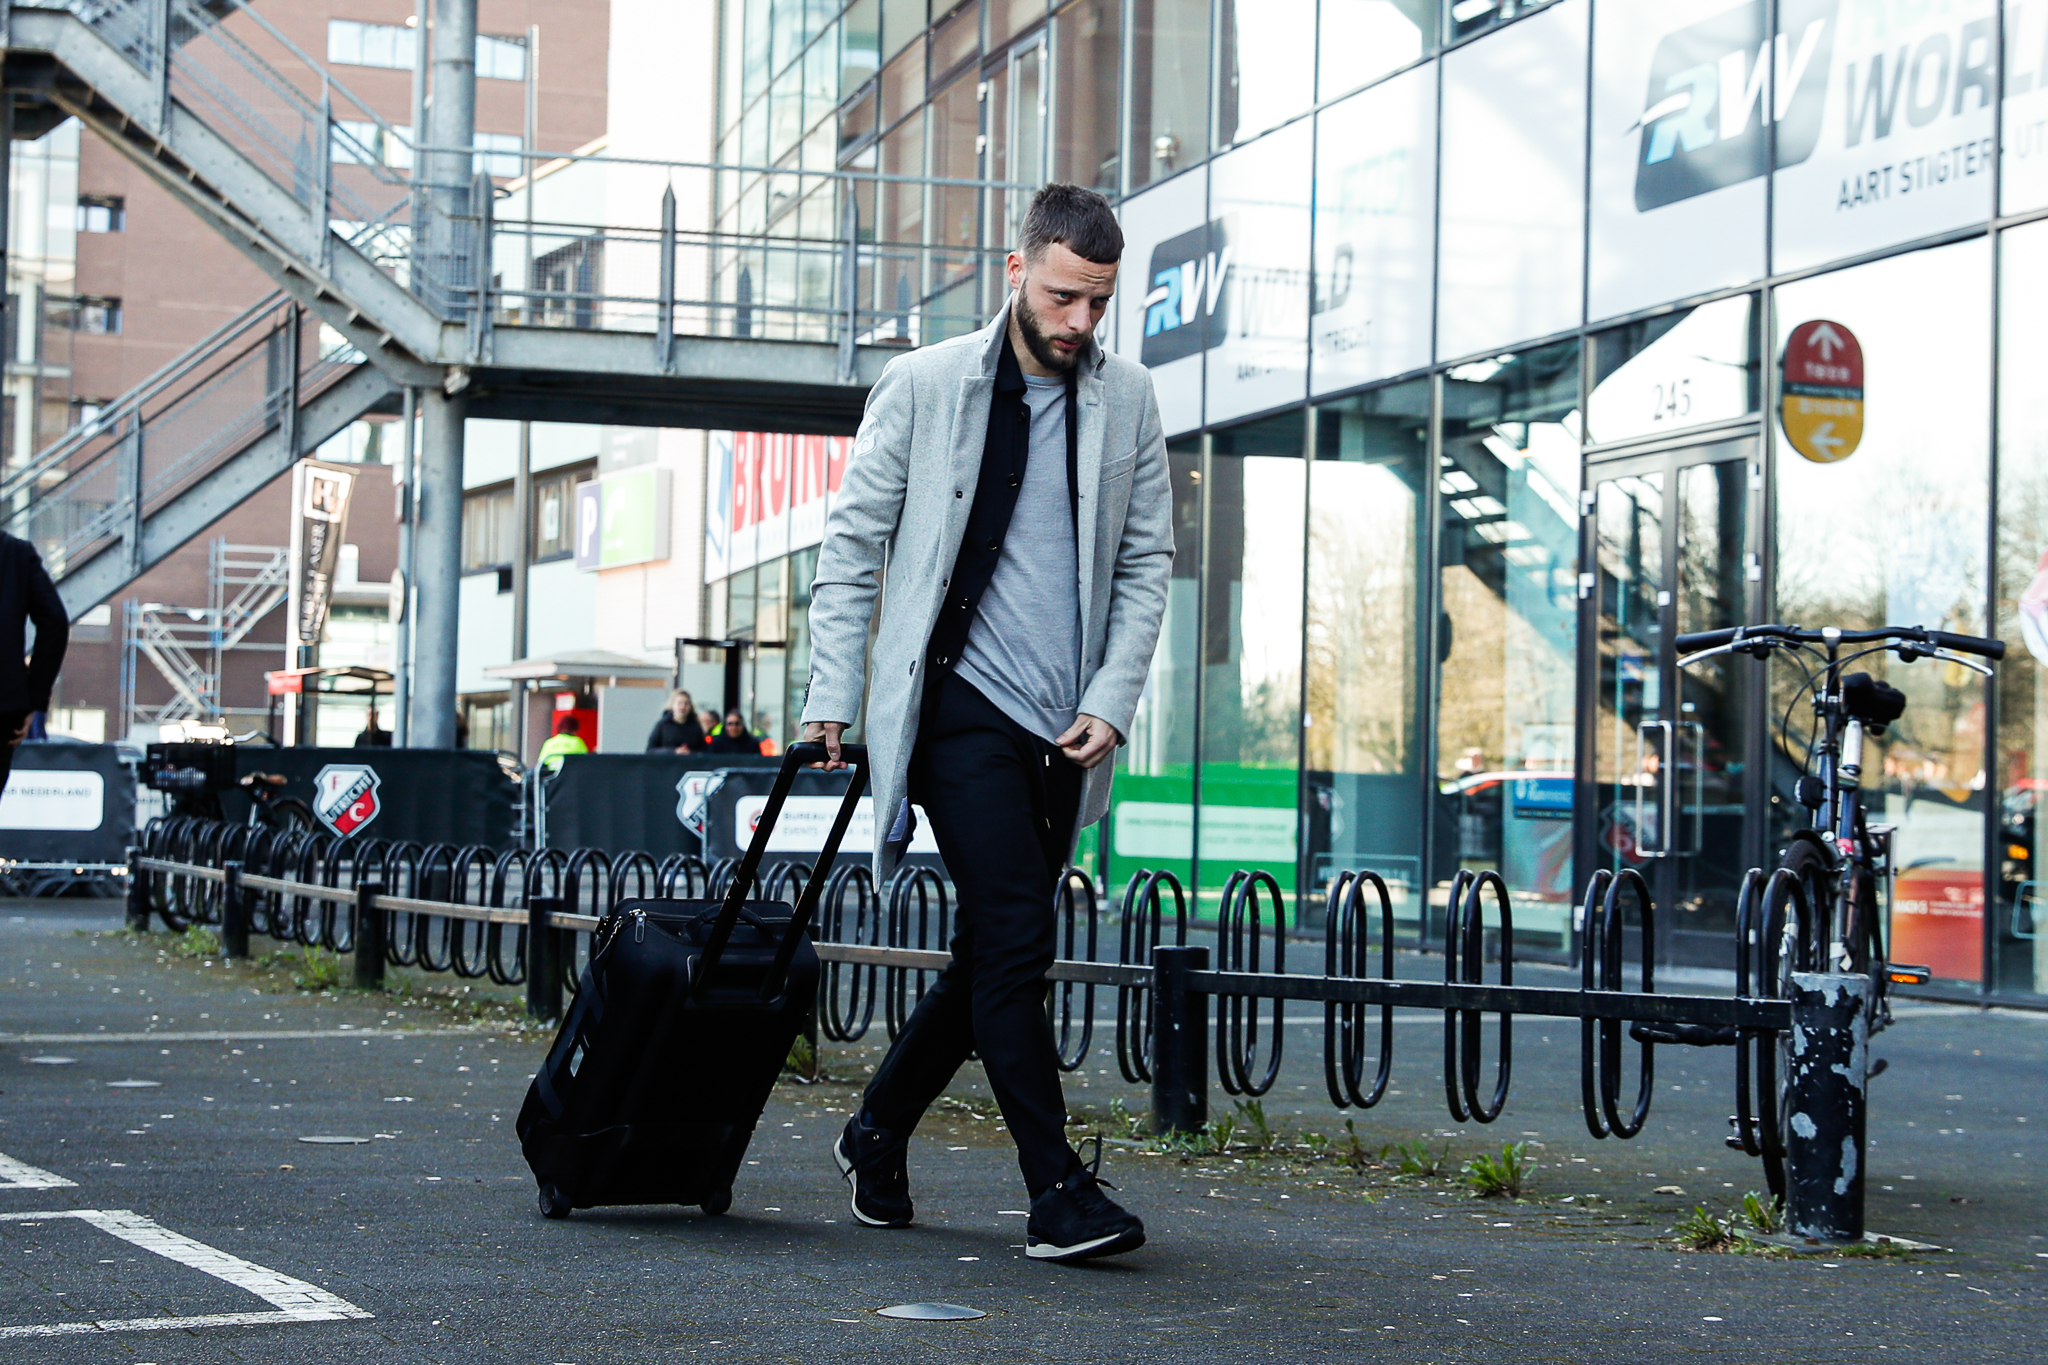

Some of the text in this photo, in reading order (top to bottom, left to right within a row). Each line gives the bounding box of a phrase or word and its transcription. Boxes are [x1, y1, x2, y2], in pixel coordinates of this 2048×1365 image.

[1844, 1, 2048, 150] WORL
[1837, 164, 1896, 213] AART
[1653, 378, 1691, 421] 245
[349, 802, 366, 822] C
